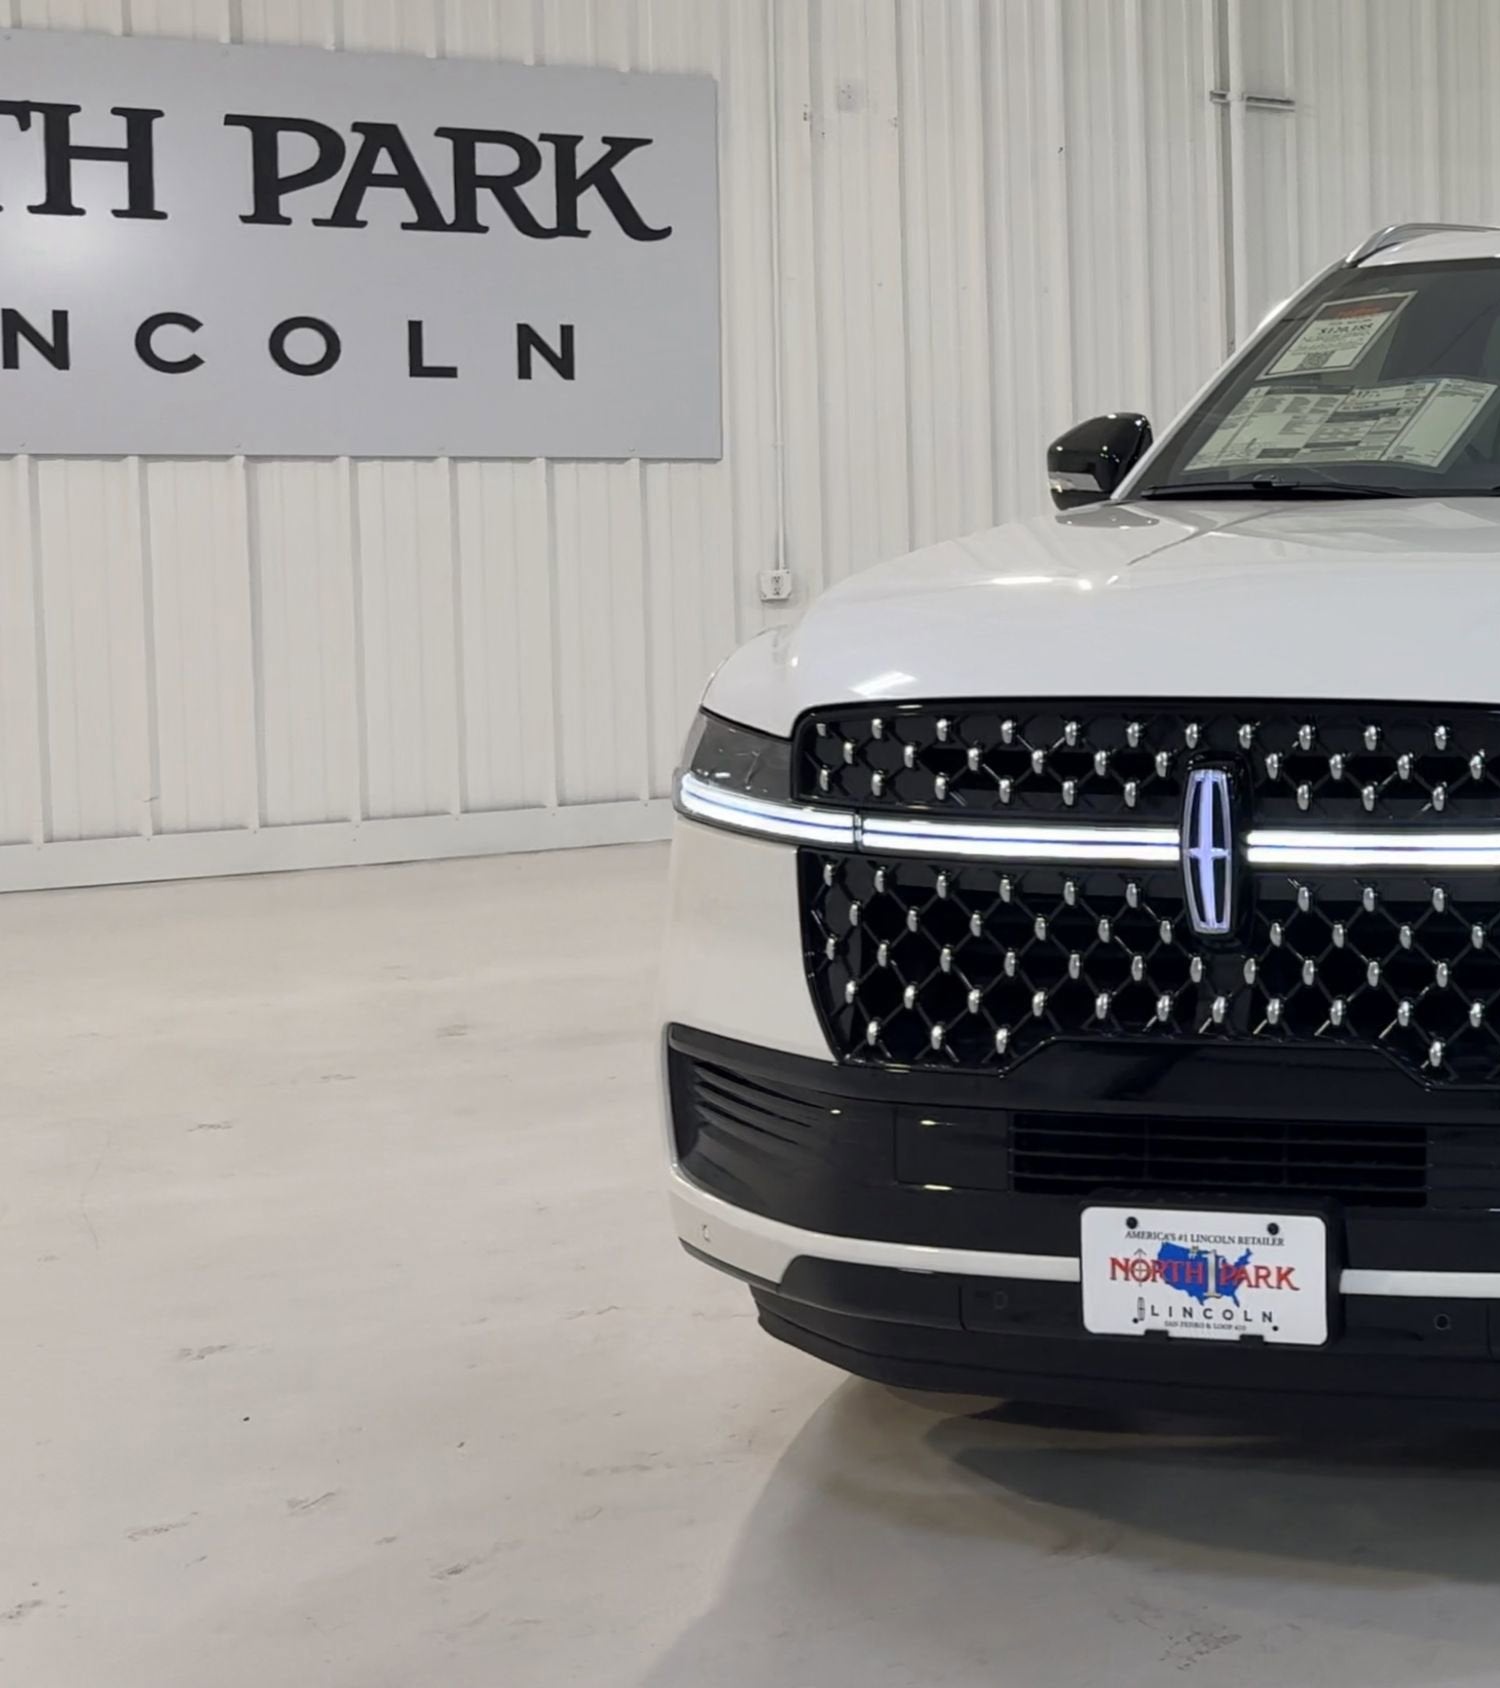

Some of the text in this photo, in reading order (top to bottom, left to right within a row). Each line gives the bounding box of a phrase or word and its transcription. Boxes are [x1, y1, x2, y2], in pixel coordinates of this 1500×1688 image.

[224, 114, 673, 242] PARK
[1190, 1234, 1236, 1244] LINCOLN
[1237, 1236, 1285, 1247] RETAILER
[1109, 1257, 1301, 1291] NORTH PARK
[1151, 1304, 1273, 1323] LINCOLN
